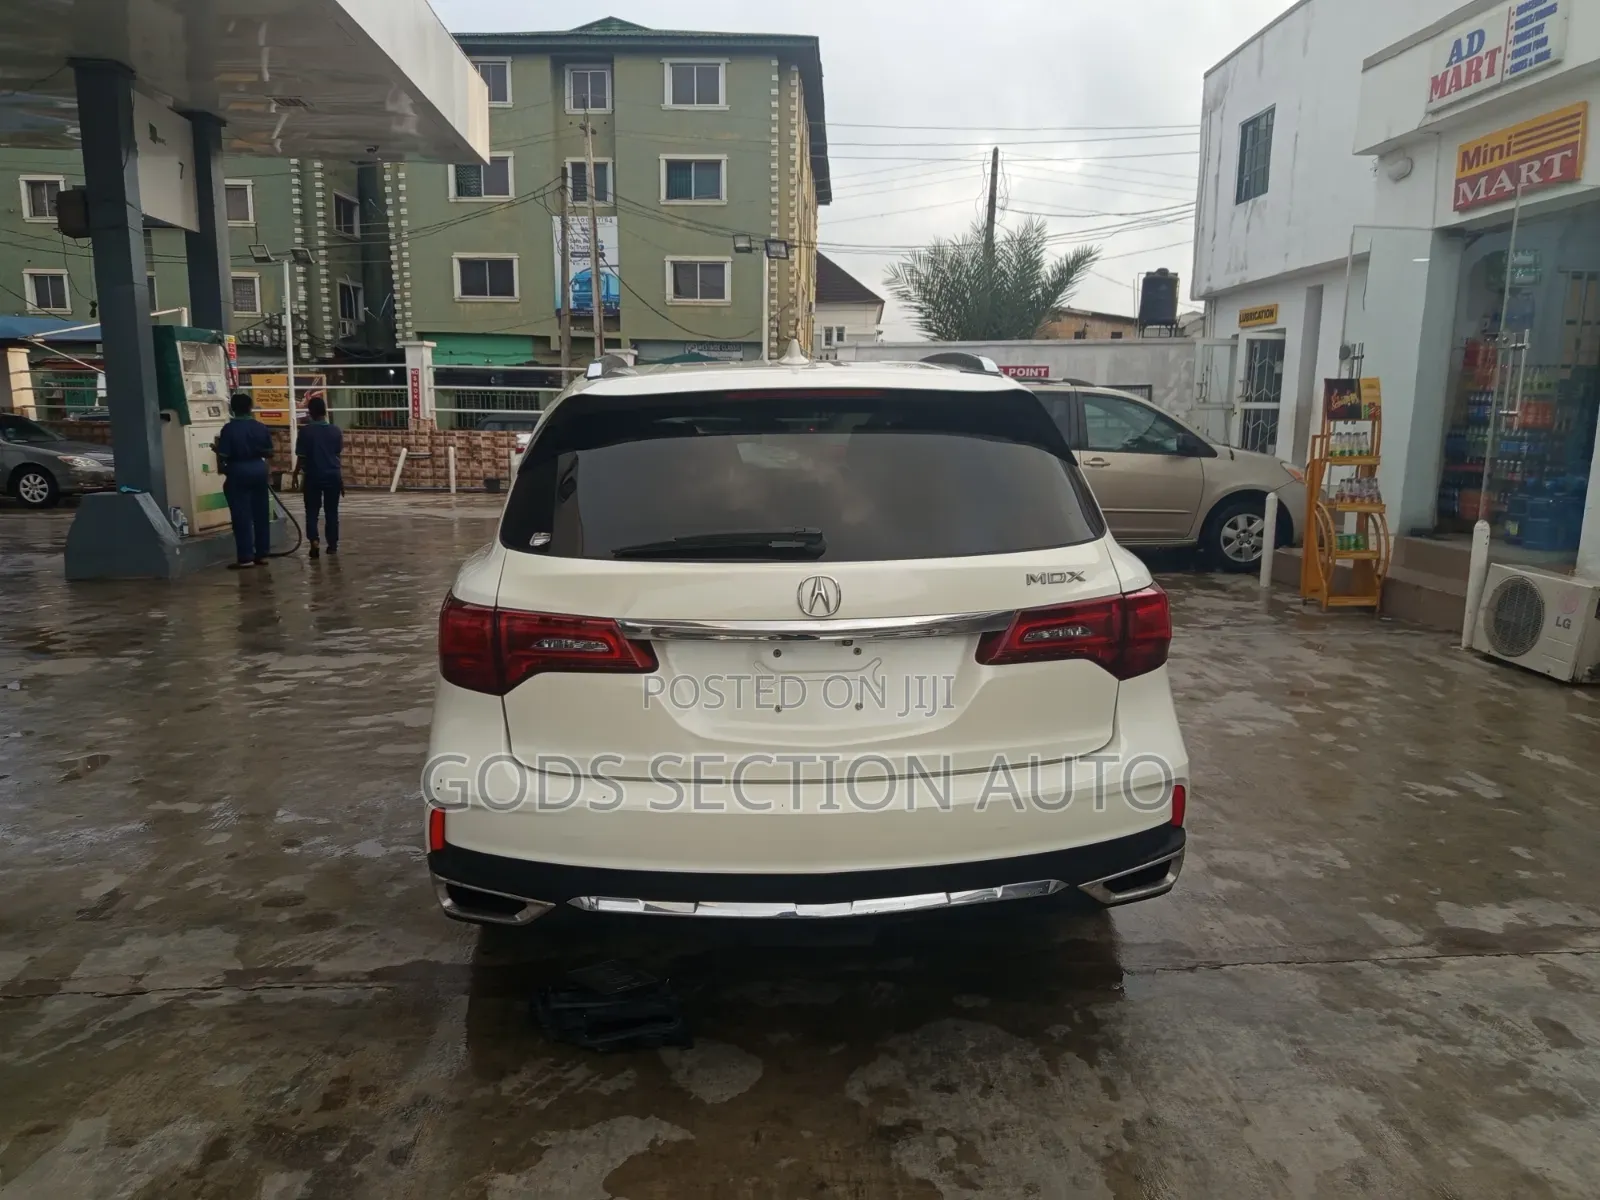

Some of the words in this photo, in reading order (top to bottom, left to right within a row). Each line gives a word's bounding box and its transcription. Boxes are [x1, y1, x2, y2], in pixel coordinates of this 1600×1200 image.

[1446, 28, 1485, 67] AD
[1428, 45, 1502, 103] MART
[1461, 134, 1514, 172] Mini
[1456, 149, 1573, 206] MART
[1239, 307, 1274, 323] LUBRICATION
[1008, 367, 1048, 377] POINT
[1025, 570, 1086, 586] MDX
[1555, 616, 1571, 630] LG
